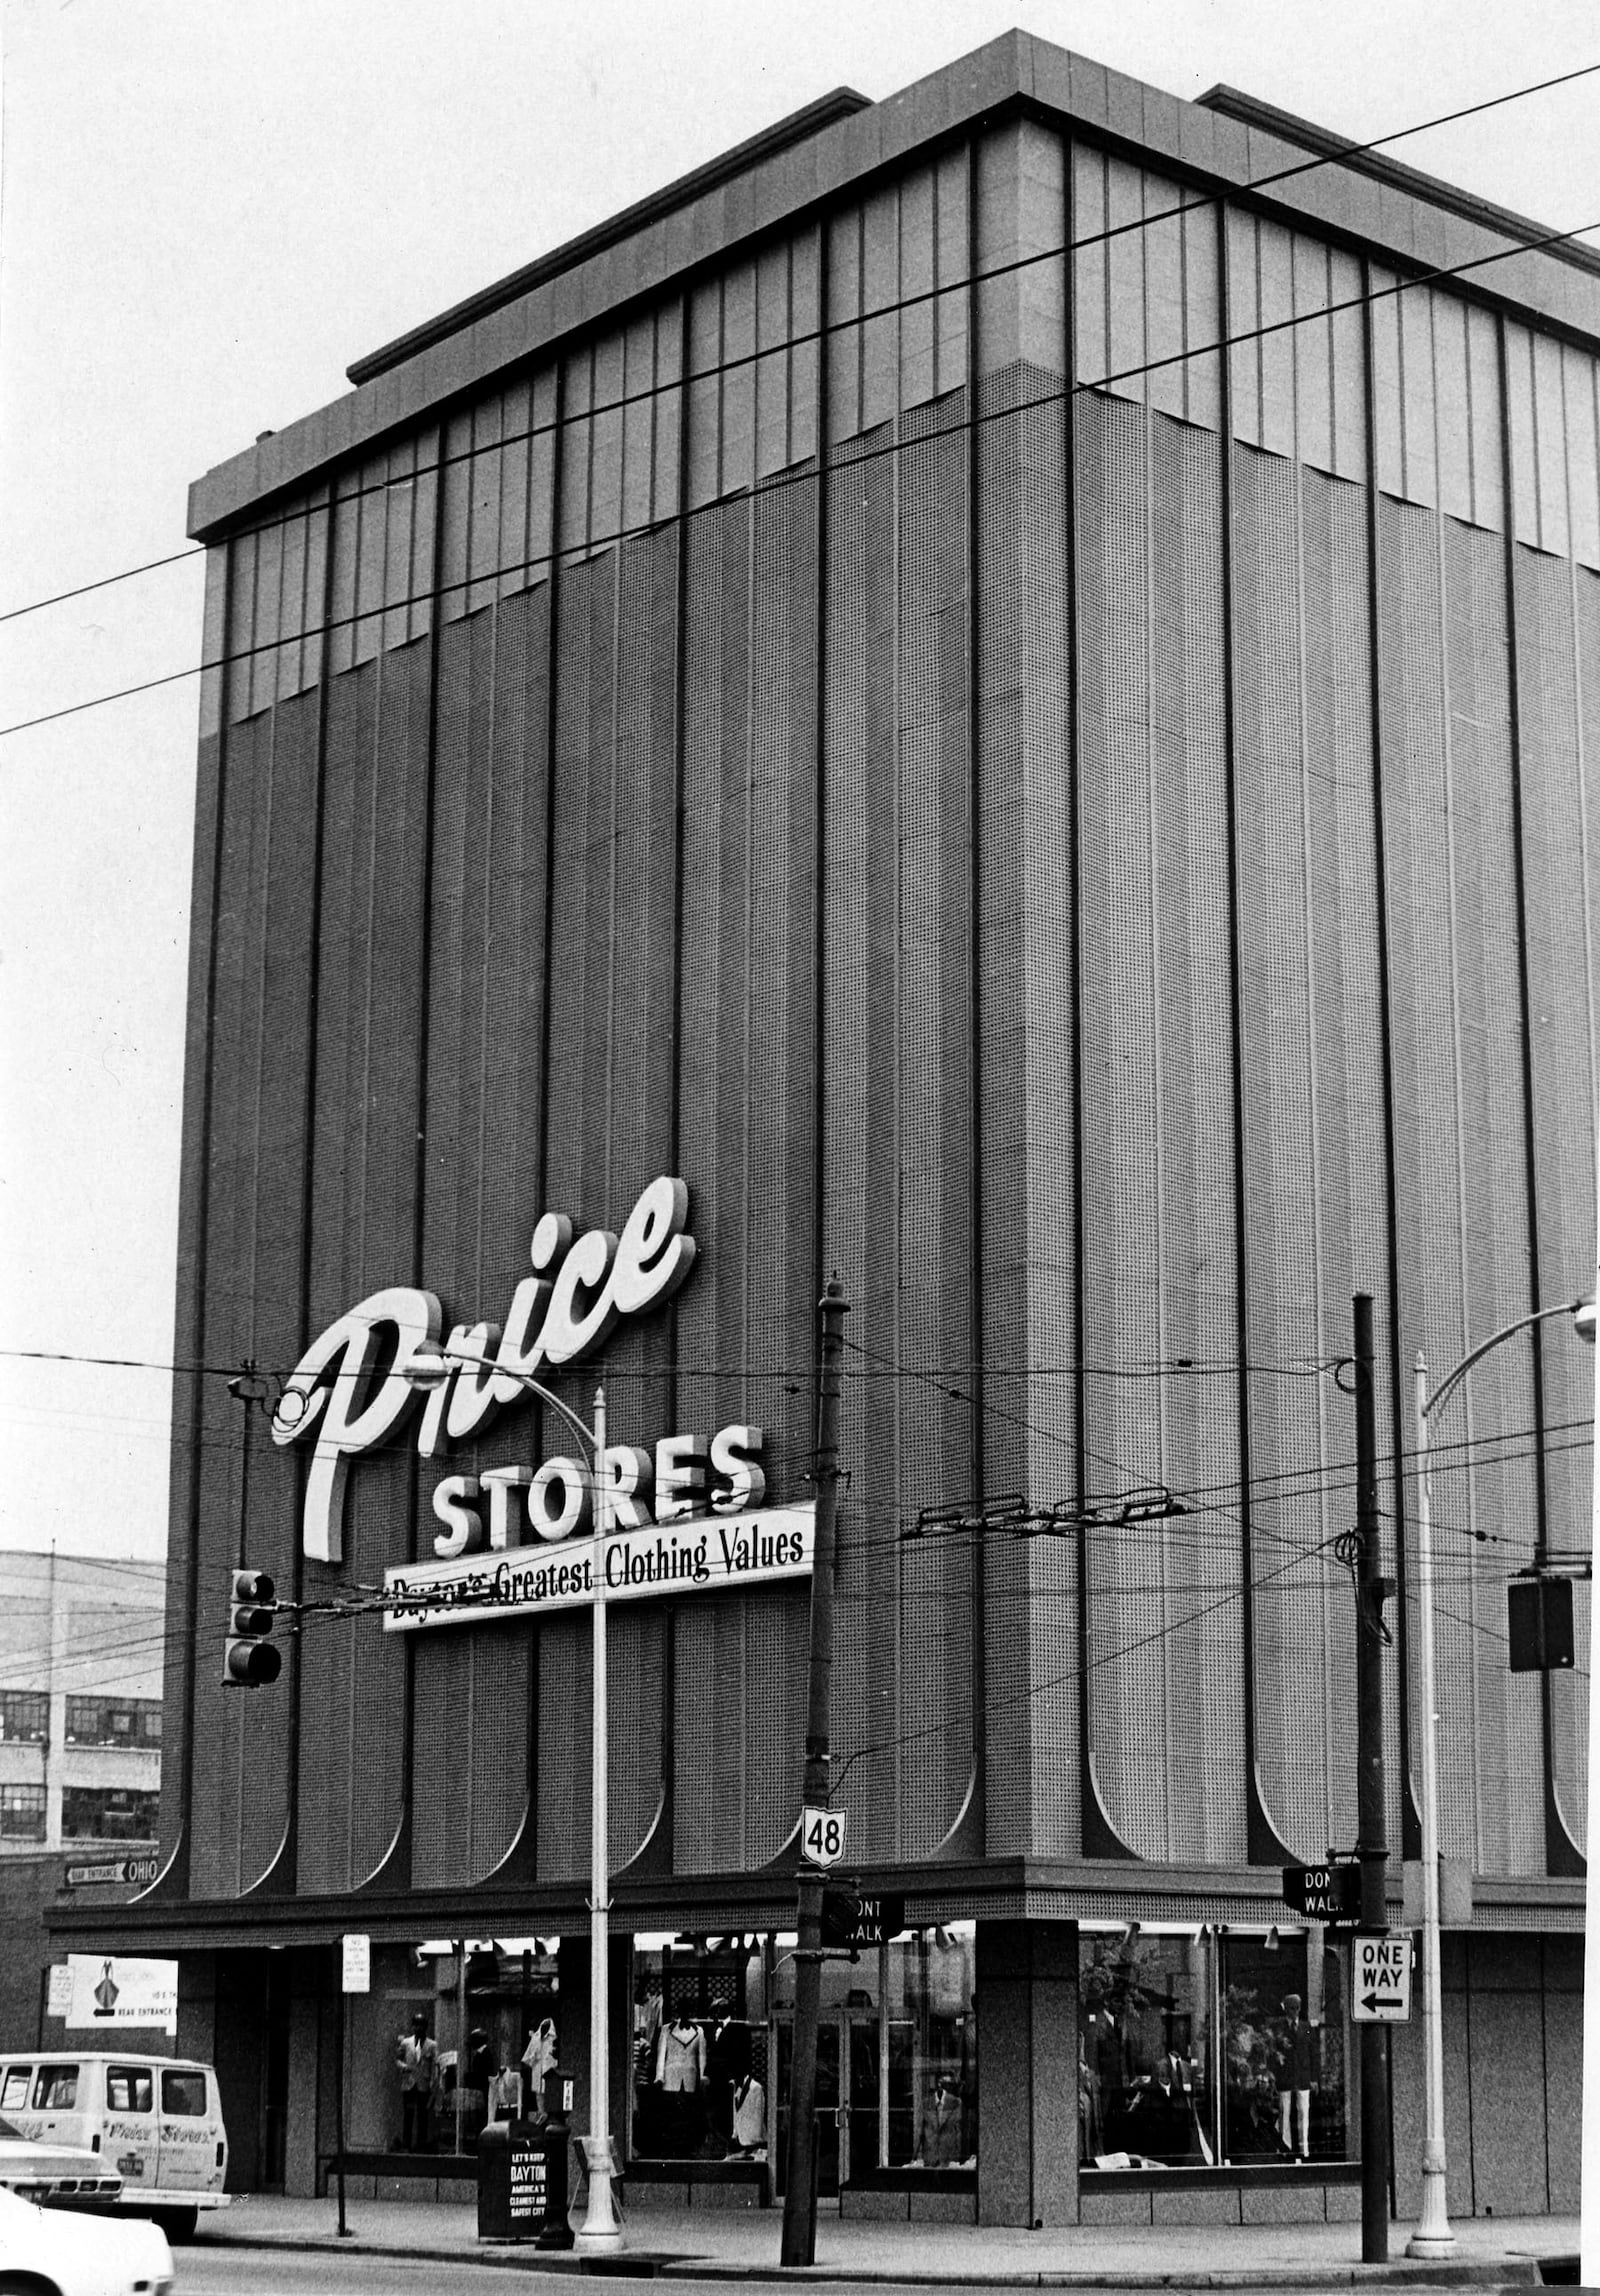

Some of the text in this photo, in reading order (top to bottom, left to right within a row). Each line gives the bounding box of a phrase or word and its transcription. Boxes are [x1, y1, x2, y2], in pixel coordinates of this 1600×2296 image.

[271, 1176, 696, 1562] Price
[433, 1424, 766, 1559] STORES
[495, 1559, 593, 1604] Greatest
[605, 1535, 709, 1583] Clothing
[719, 1524, 803, 1575] Values
[807, 1819, 840, 1855] 48
[128, 1860, 158, 1881] OHIO
[1305, 1872, 1331, 1888] DON
[1305, 1897, 1343, 1912] WAL
[846, 1924, 882, 1941] ALK
[1363, 1945, 1403, 1965] ONE
[1363, 1968, 1403, 1988] WAY
[138, 2007, 172, 2016] ENTRANCE
[512, 2152, 545, 2163] LET'S KEEP
[510, 2165, 546, 2182] DAYTON
[511, 2185, 545, 2194] AMERICA'S
[509, 2196, 547, 2206] CLEANEST AND
[511, 2206, 545, 2217] SAFEST CITY
